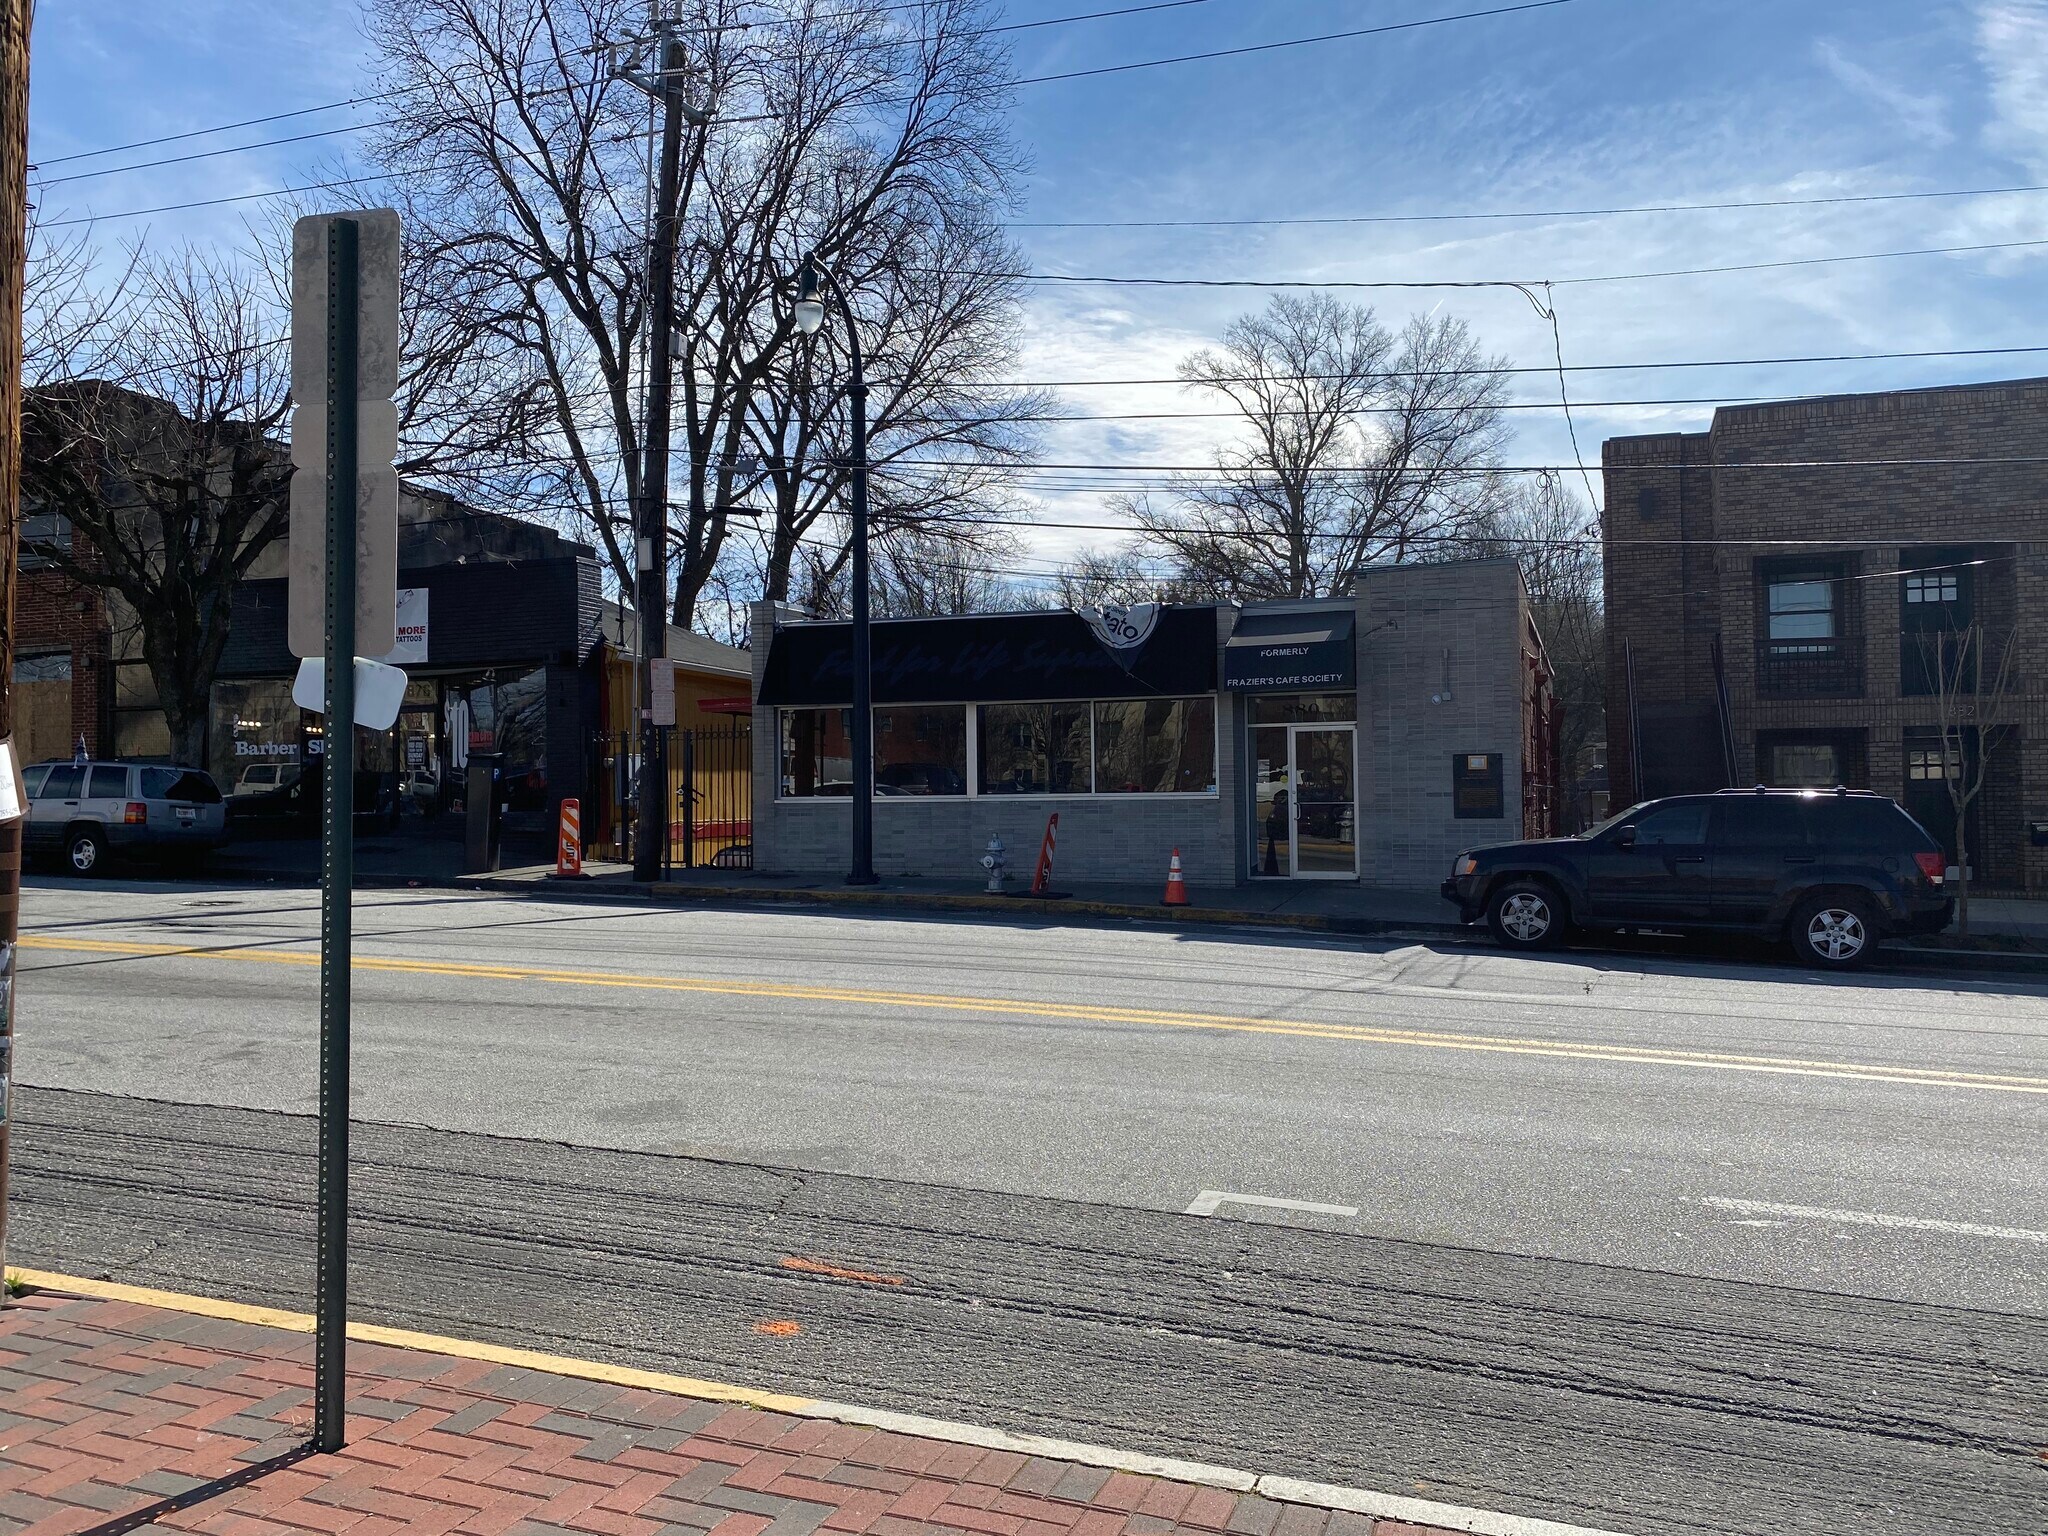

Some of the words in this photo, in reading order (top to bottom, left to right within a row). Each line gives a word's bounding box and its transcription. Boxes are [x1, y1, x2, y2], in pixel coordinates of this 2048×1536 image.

[398, 625, 426, 635] MORE
[396, 635, 422, 643] TATTOOS
[1260, 647, 1310, 657] FORMERLY
[1227, 676, 1274, 687] FRAZIER'S
[1275, 675, 1300, 684] CAFE
[1301, 673, 1343, 683] SOCIETY
[234, 740, 298, 756] Barber
[493, 767, 500, 779] P
